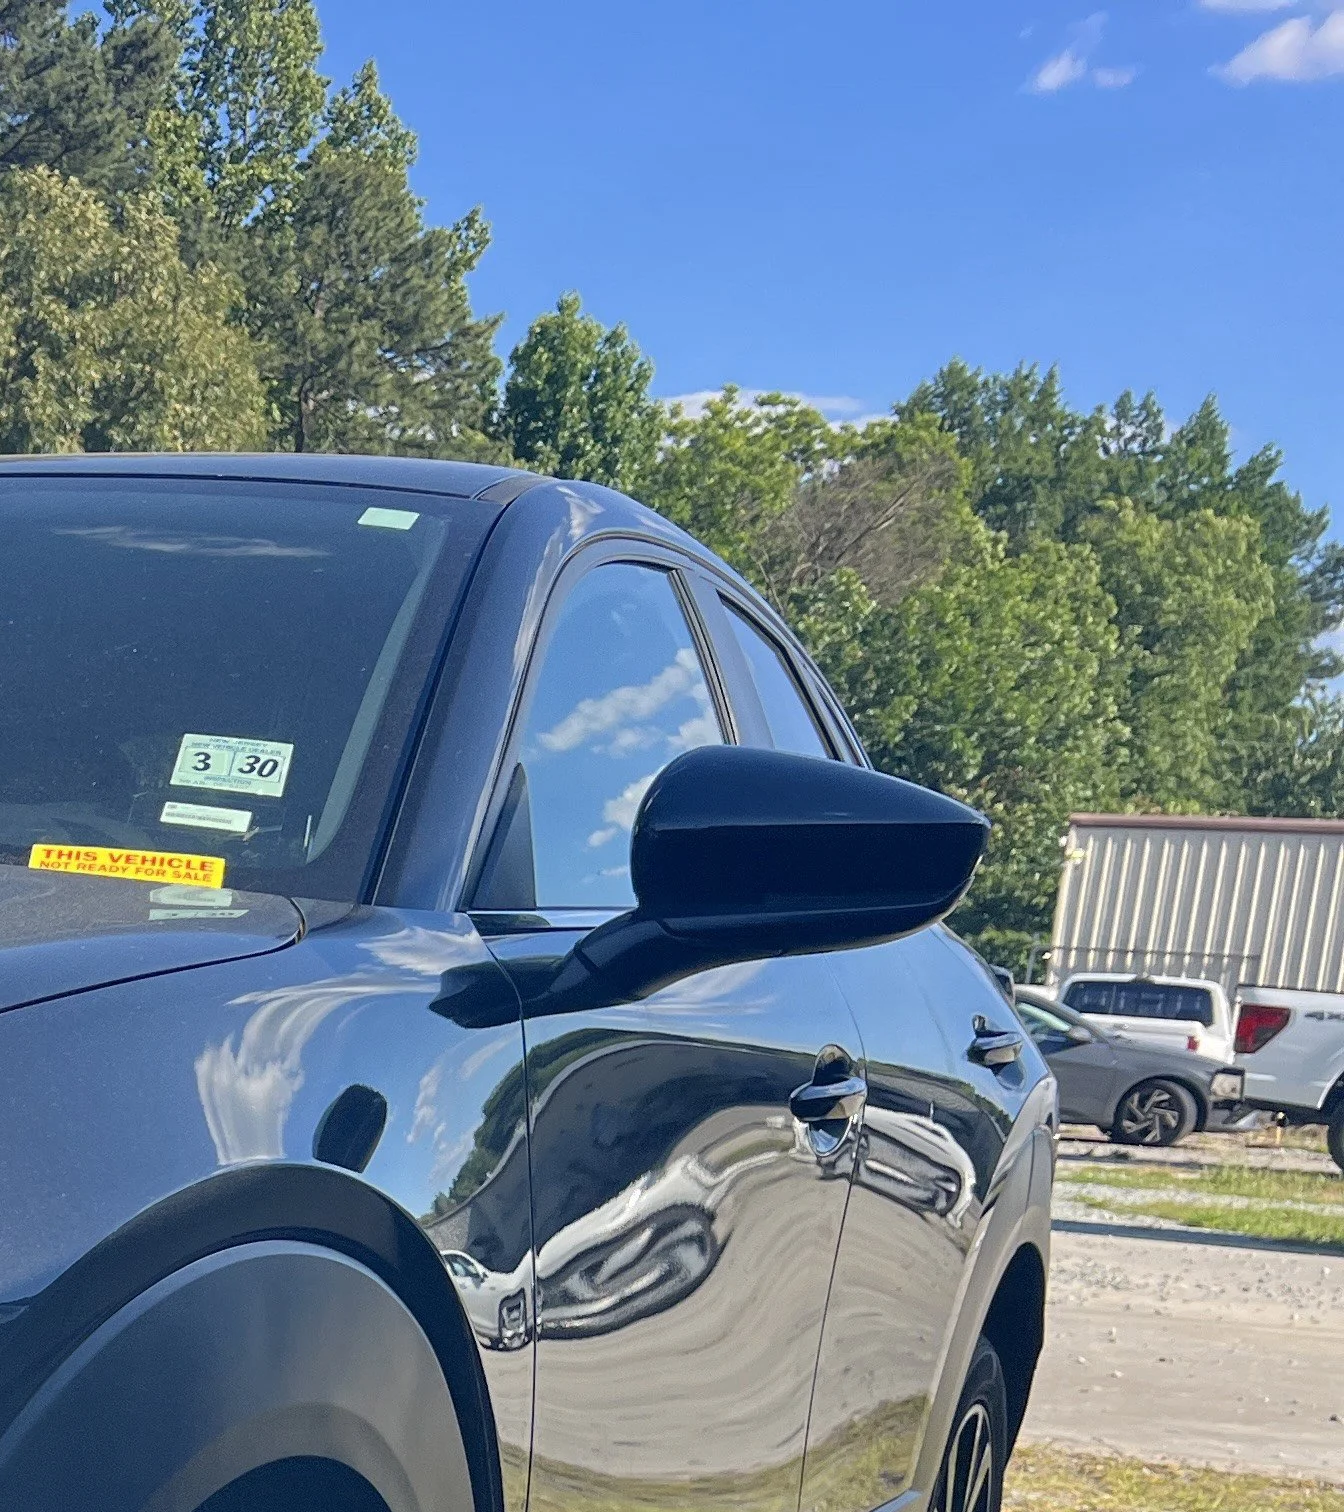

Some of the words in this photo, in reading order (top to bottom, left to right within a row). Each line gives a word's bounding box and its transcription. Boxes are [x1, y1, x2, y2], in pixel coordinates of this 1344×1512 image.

[191, 751, 212, 772] 3
[237, 754, 280, 779] 30
[39, 860, 72, 870] NOT
[76, 862, 130, 874] READY
[134, 867, 167, 878] FOR
[171, 870, 213, 883] SALE
[43, 848, 98, 862] THIS
[107, 853, 216, 873] VEHICLE
